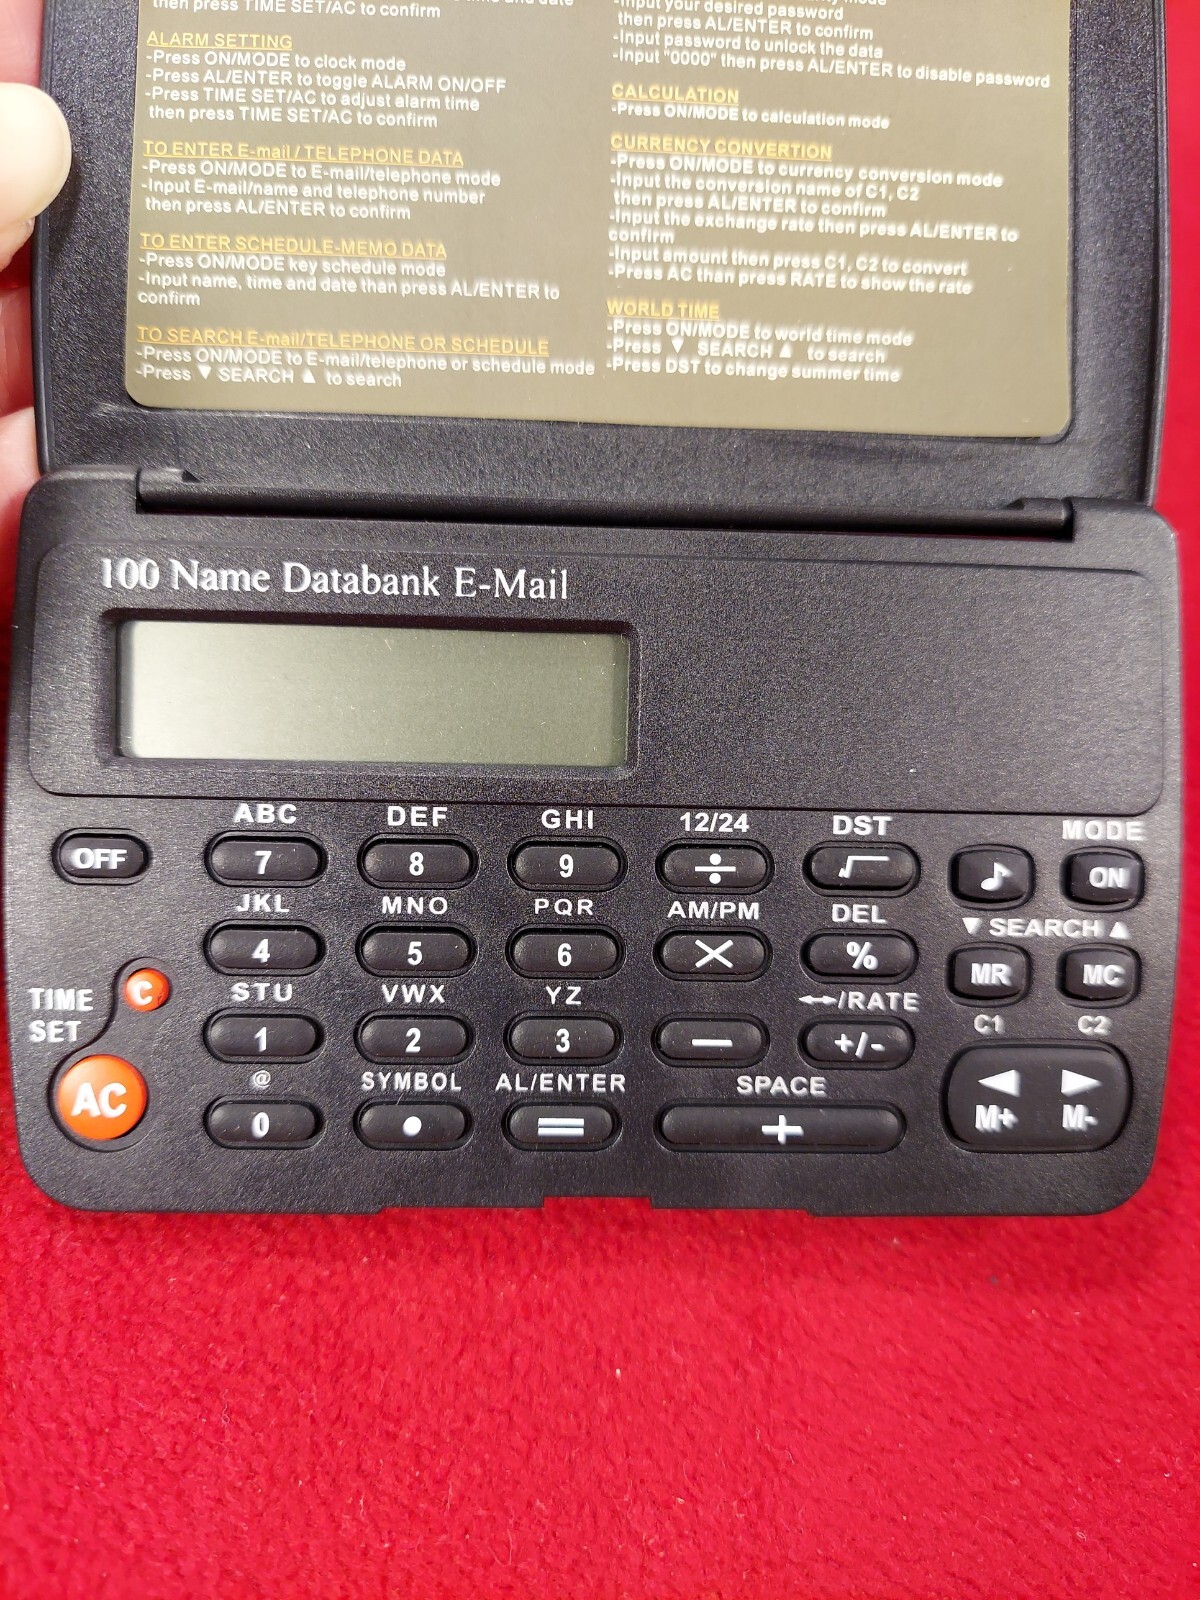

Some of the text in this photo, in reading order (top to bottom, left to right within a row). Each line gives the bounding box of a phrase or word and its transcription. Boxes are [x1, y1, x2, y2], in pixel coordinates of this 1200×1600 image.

[617, 11, 873, 39] then press AL/ENTER to confirm
[146, 32, 292, 48] ALARM SETTING
[613, 29, 882, 58] -Input password to unlock the data
[146, 50, 405, 70] -Press ON/MODE to clock mode
[612, 48, 1050, 90] -Input "0000" then press AL/ENTER to disable password
[145, 68, 506, 91] -Press AL/ENTER to toggle ALARM ON/OFF
[612, 84, 738, 101] CALCULATION
[148, 105, 437, 126] then press TIME SET/AC to confirm
[611, 101, 889, 129] -Press ON/MODE to calculation mode
[144, 140, 167, 156] TO
[172, 143, 232, 158] ENTER
[237, 145, 290, 160] E-mail
[305, 147, 413, 164] TELEPHONE
[418, 151, 463, 166] DATA
[610, 135, 831, 157] CURRENCY CONVERTION
[142, 159, 500, 186] -Press ON/MODE to E-mail/telephone mode
[610, 154, 1003, 186] -Press ON/MODE to currency conversion mode
[141, 178, 485, 203] -Input E-mail/name and telephone number
[145, 197, 410, 218] then press AL/ENTER to confirm
[140, 234, 446, 259] TO ENTER SCHEDULE-MEMO DATA
[139, 252, 445, 276] -Press ON/MODE key schedule mode
[607, 300, 718, 318] WORLD TIME
[138, 326, 547, 354] TO SEARCH E-mail/TELEPHONE OR SCHEDULE
[607, 319, 913, 345] -Press ON/MODE to world time mode
[137, 346, 594, 374] -Press ON/MODE to E-mail/telephone or schedule mode
[102, 558, 567, 600] 100 Name Databank E-Mail
[234, 804, 297, 824] ABC
[387, 806, 448, 826] DEF
[541, 810, 594, 829] GHI
[680, 813, 749, 833] 12/24
[833, 816, 892, 835] DST
[1062, 821, 1146, 840] MODE
[74, 848, 127, 869] OFF
[255, 851, 271, 874] 7
[409, 852, 424, 876] 8
[559, 854, 574, 878] 9
[1089, 868, 1130, 888] ON
[237, 894, 289, 913] JKL
[382, 897, 448, 914] MNO
[534, 899, 594, 916] PQR
[668, 902, 759, 920] AM/PM
[832, 904, 887, 923] DEL
[989, 919, 1102, 938] SEARCH
[252, 939, 270, 963] 4
[407, 942, 422, 965] 5
[557, 943, 572, 966] 6
[846, 942, 878, 970] %
[971, 964, 1013, 986] MR
[1083, 965, 1125, 987] MC
[28, 988, 93, 1011] TIME
[135, 981, 153, 1004] C
[231, 983, 293, 1001] STU
[382, 985, 445, 1002] VWX
[546, 987, 582, 1005] YZ
[29, 1021, 81, 1042] SET
[974, 1015, 1004, 1034] C1
[1078, 1016, 1113, 1035] C2
[255, 1028, 267, 1051] 1
[406, 1028, 421, 1053] 2
[556, 1029, 570, 1052] 3
[254, 1070, 271, 1088] @
[361, 1072, 462, 1091] SYMBOL
[496, 1073, 626, 1092] AL/ENTER
[737, 1076, 827, 1096] SPACE
[71, 1083, 127, 1117] AC
[254, 1113, 270, 1138] 0
[975, 1105, 1018, 1130] M+
[1062, 1105, 1098, 1130] M-
